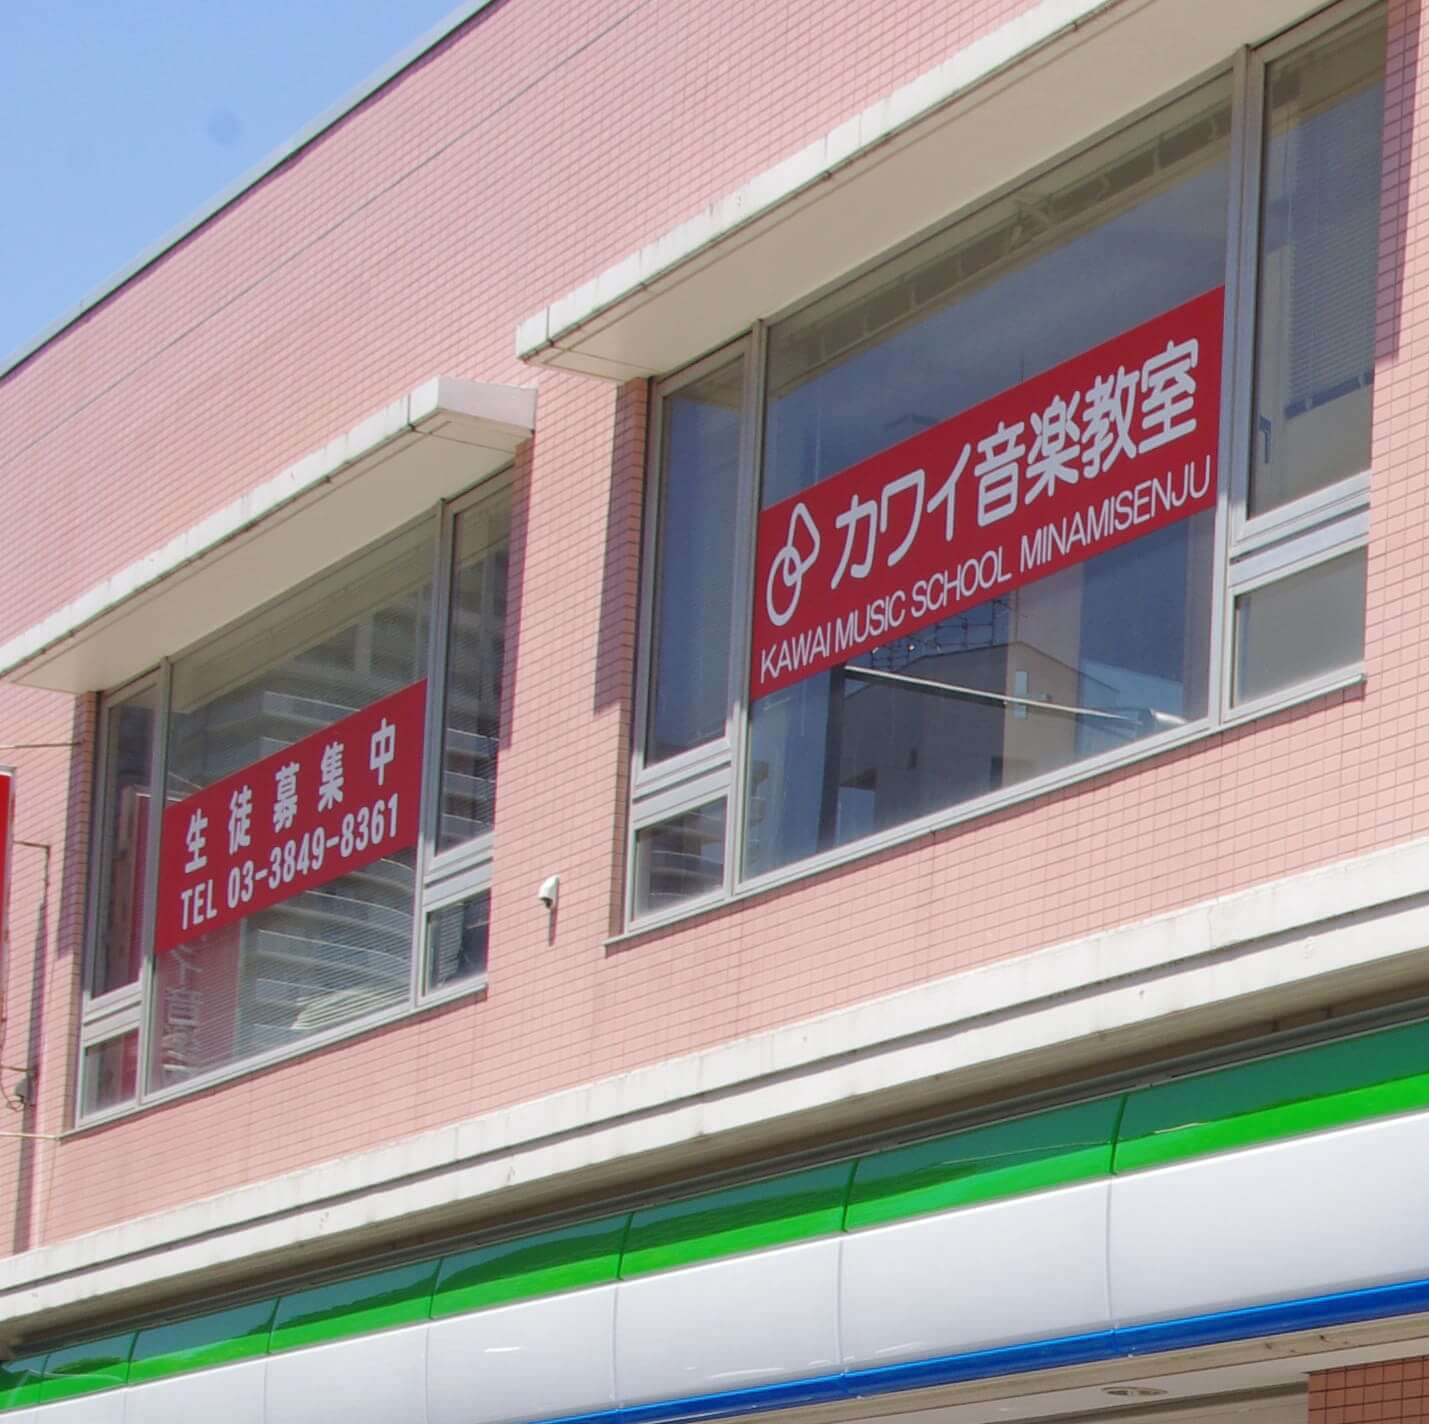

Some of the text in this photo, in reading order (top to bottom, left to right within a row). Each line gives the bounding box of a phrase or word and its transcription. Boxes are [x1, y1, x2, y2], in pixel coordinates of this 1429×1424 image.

[831, 337, 1200, 590] カワイ音楽教室
[759, 455, 1211, 683] KAWAI MUSIC SCHOOL MINAMISENJU
[180, 794, 399, 930] TEL 03-3849-8361
[184, 716, 397, 876] 生徒募集中
